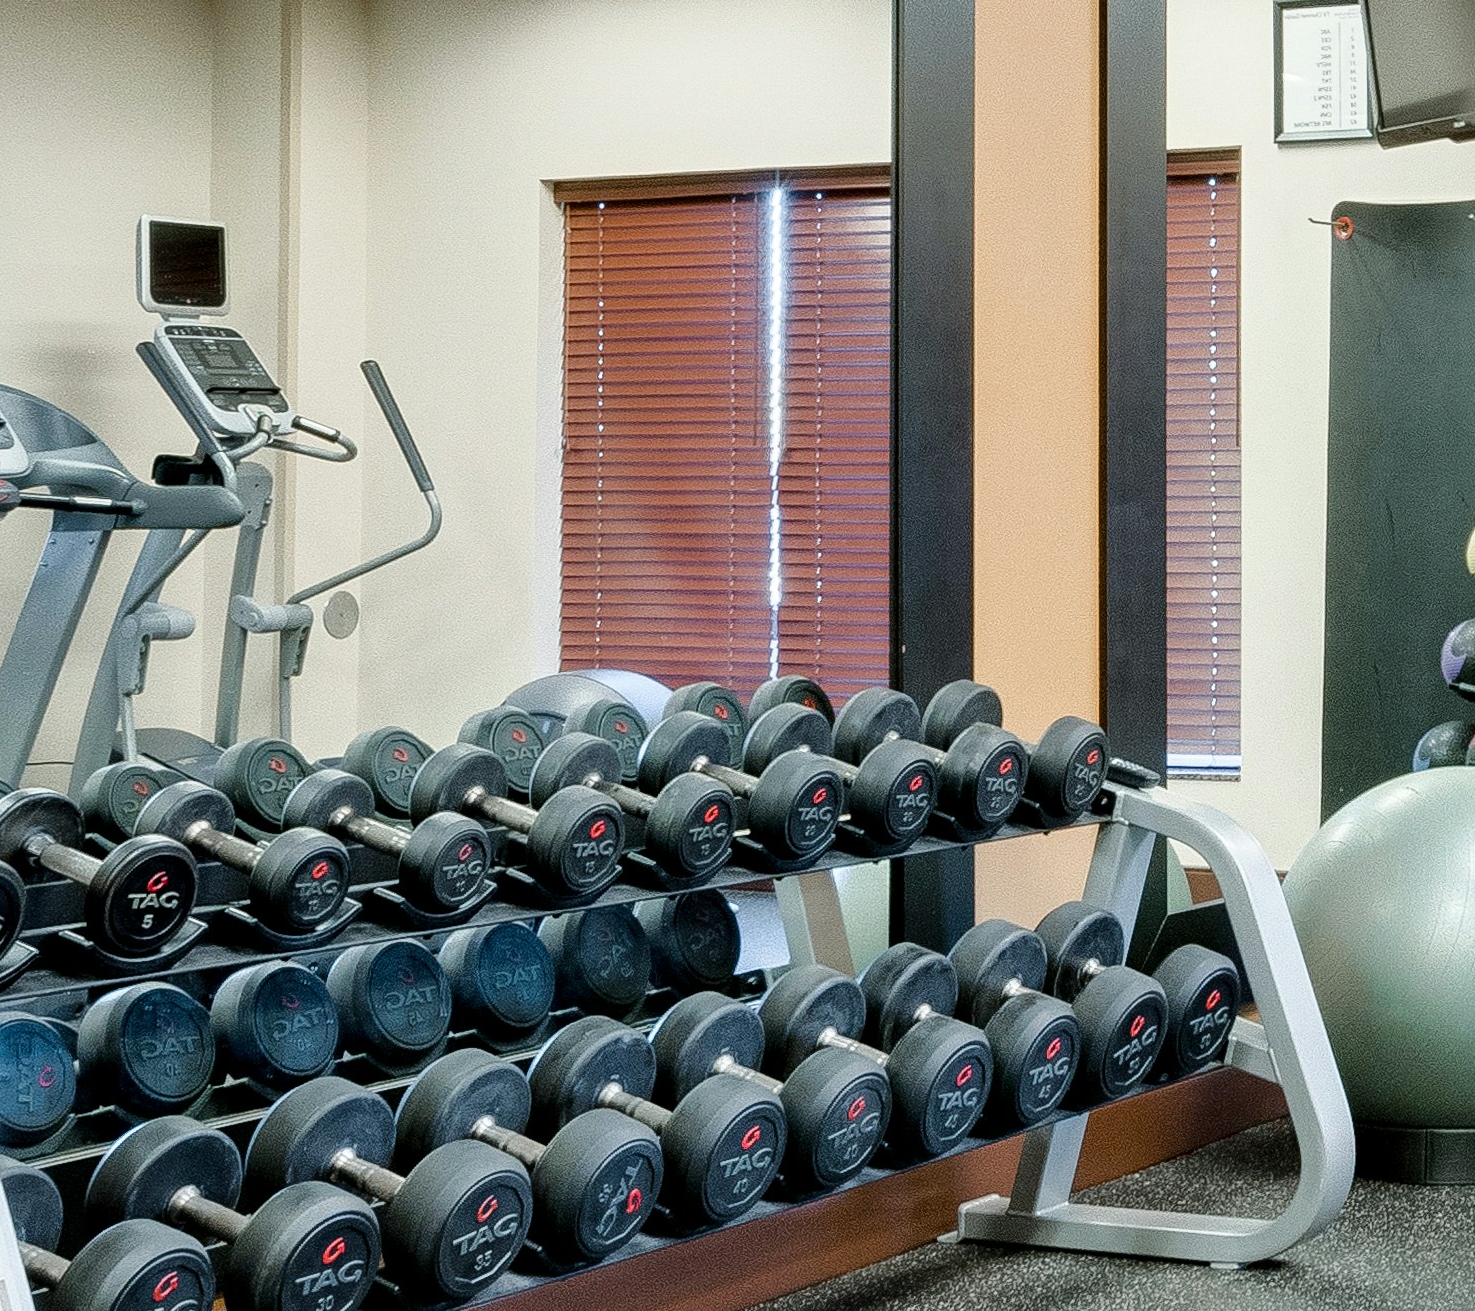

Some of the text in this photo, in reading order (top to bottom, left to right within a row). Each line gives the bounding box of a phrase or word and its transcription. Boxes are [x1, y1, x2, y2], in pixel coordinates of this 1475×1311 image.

[985, 776, 1018, 793] TAG
[1074, 763, 1099, 787] TAG
[896, 792, 929, 808] TAG
[798, 806, 833, 821] TAG
[689, 822, 728, 842] TAG
[573, 839, 615, 858] TAG
[442, 860, 484, 880] TAG
[295, 880, 340, 897] TAG
[127, 891, 180, 910] TAG
[141, 914, 154, 929] 5
[1189, 1006, 1230, 1035] TAG
[1112, 1025, 1158, 1065] TAG
[1029, 1057, 1071, 1086] TAG
[938, 1087, 980, 1111] TAG
[828, 1112, 882, 1148] TAG
[720, 1147, 773, 1178] TAG
[453, 1213, 518, 1256] TAG
[295, 1259, 365, 1296] TAG
